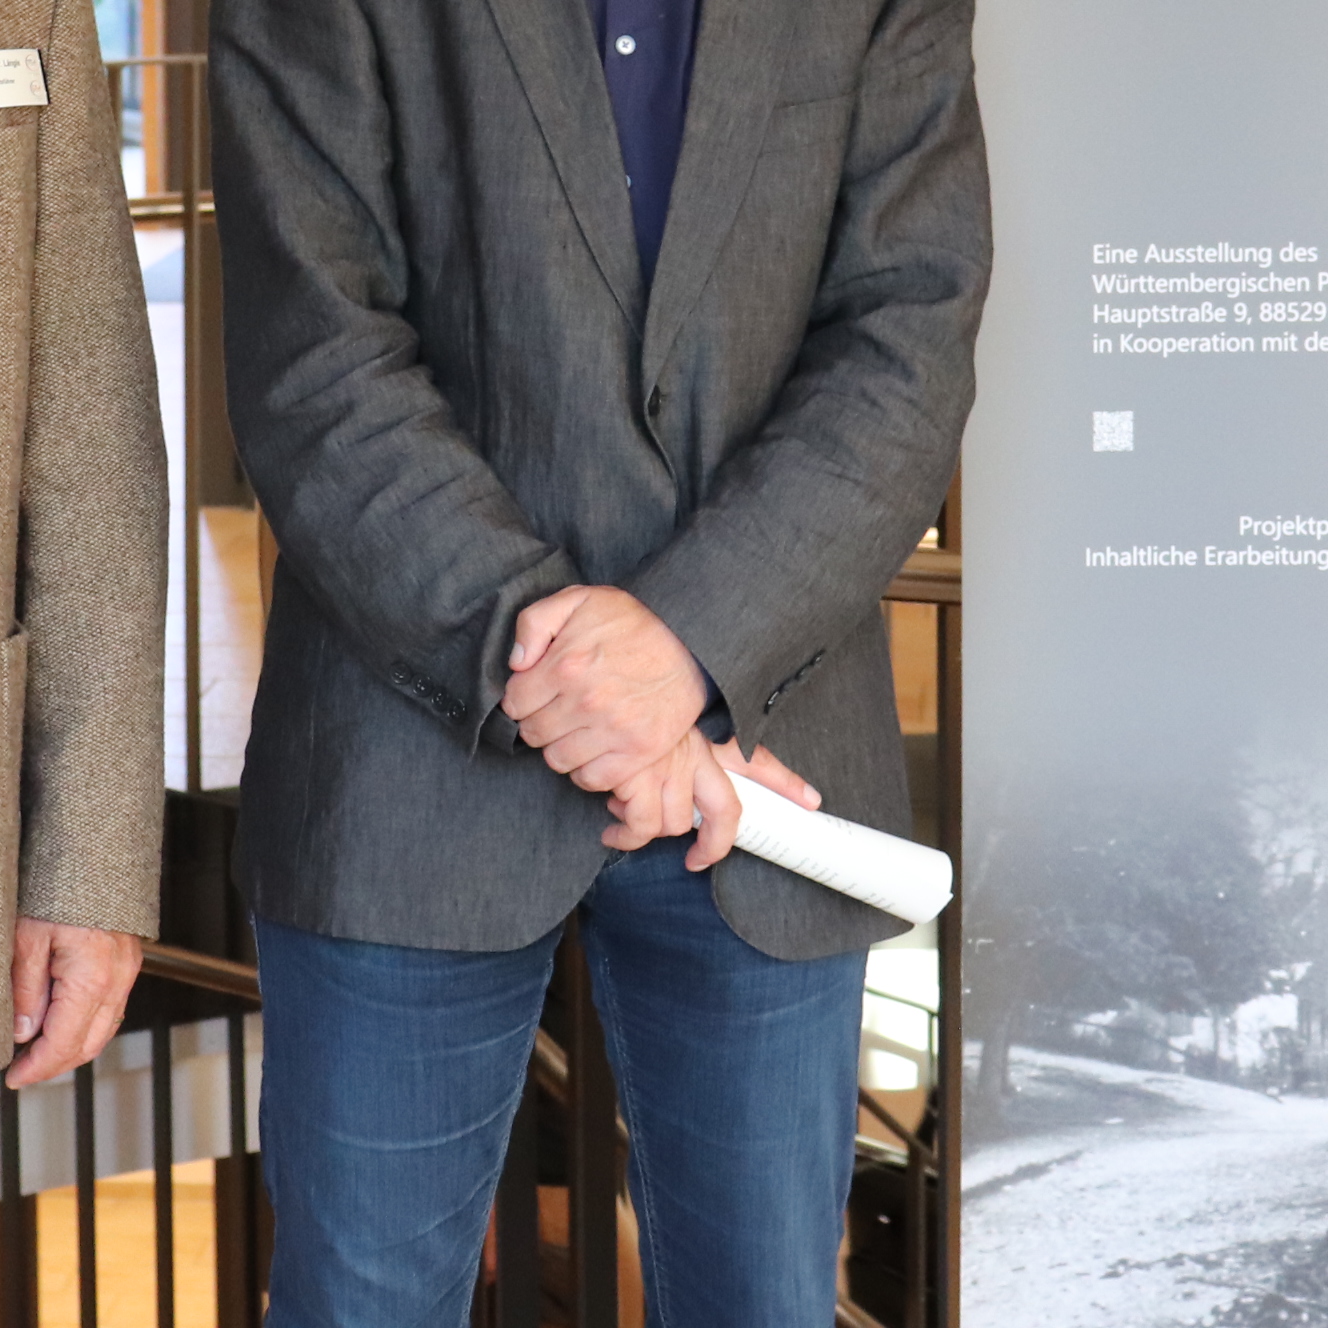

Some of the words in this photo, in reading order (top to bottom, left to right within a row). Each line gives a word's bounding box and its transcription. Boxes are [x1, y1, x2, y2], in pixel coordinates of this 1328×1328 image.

[1092, 242, 1139, 265] Eine
[1143, 241, 1273, 269] Ausstellung
[1278, 240, 1319, 263] des
[1090, 271, 1311, 299] Württembergischen
[1092, 300, 1228, 329] Hauptstraße
[1233, 301, 1253, 326] 9,
[1258, 301, 1328, 323] 88529
[1092, 332, 1113, 354] in
[1119, 331, 1256, 359] Kooperation
[1261, 330, 1299, 353] mit
[1085, 544, 1199, 567] Inhaltliche
